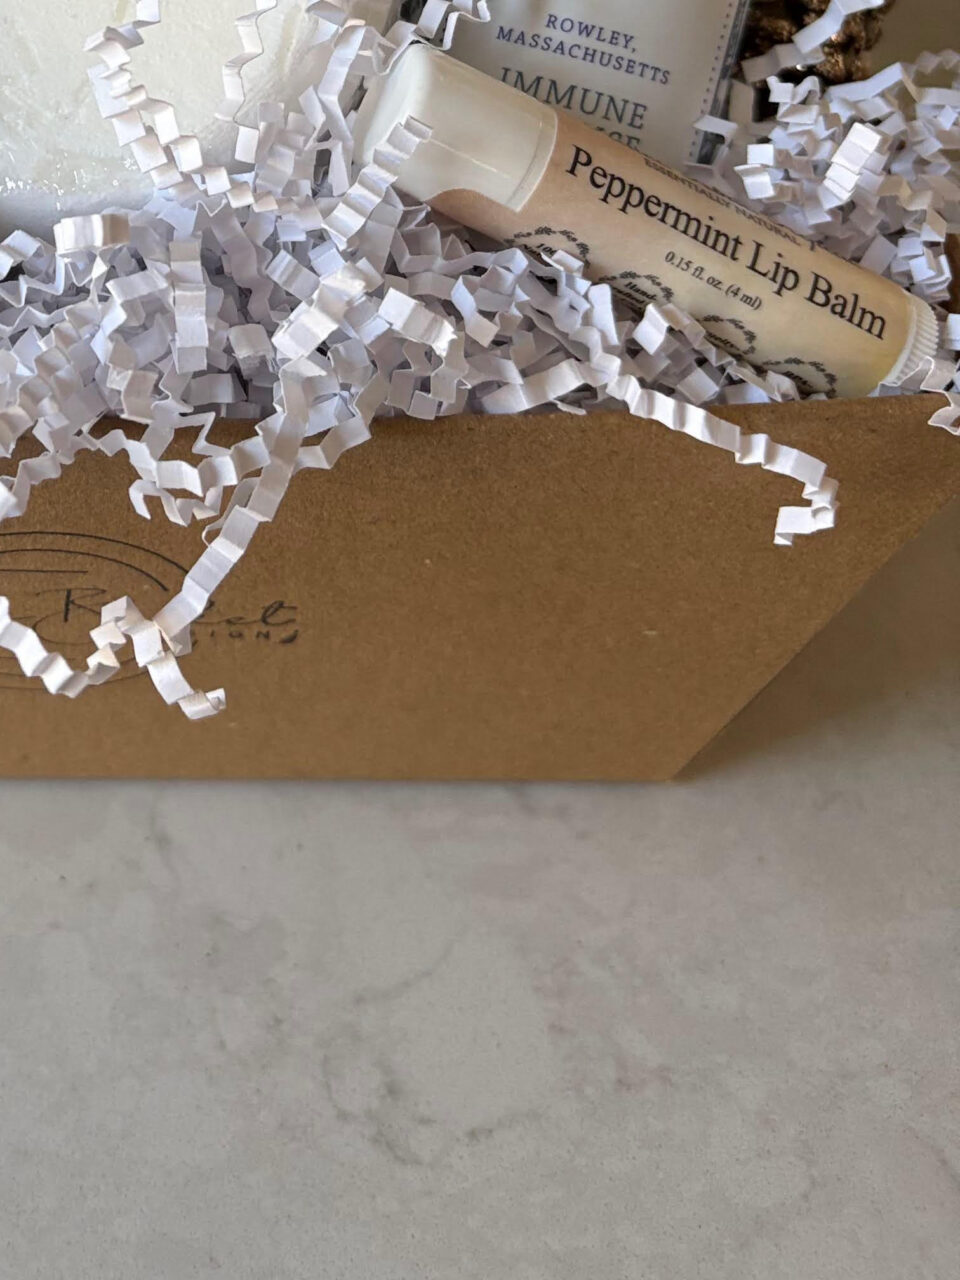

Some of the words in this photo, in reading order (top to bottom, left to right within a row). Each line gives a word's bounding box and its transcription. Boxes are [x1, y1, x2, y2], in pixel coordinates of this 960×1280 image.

[496, 26, 671, 86] MASSACHUSETTS
[545, 13, 637, 53] ROWLEY,
[500, 67, 648, 130] IMMUNE
[567, 144, 744, 262] Peppermint
[746, 239, 800, 297] Lip
[804, 270, 888, 341] Balm
[664, 250, 690, 272] 0.15
[690, 265, 708, 281] fl.
[706, 276, 722, 290] oz.
[725, 282, 741, 300] (4
[739, 291, 763, 311] ml)
